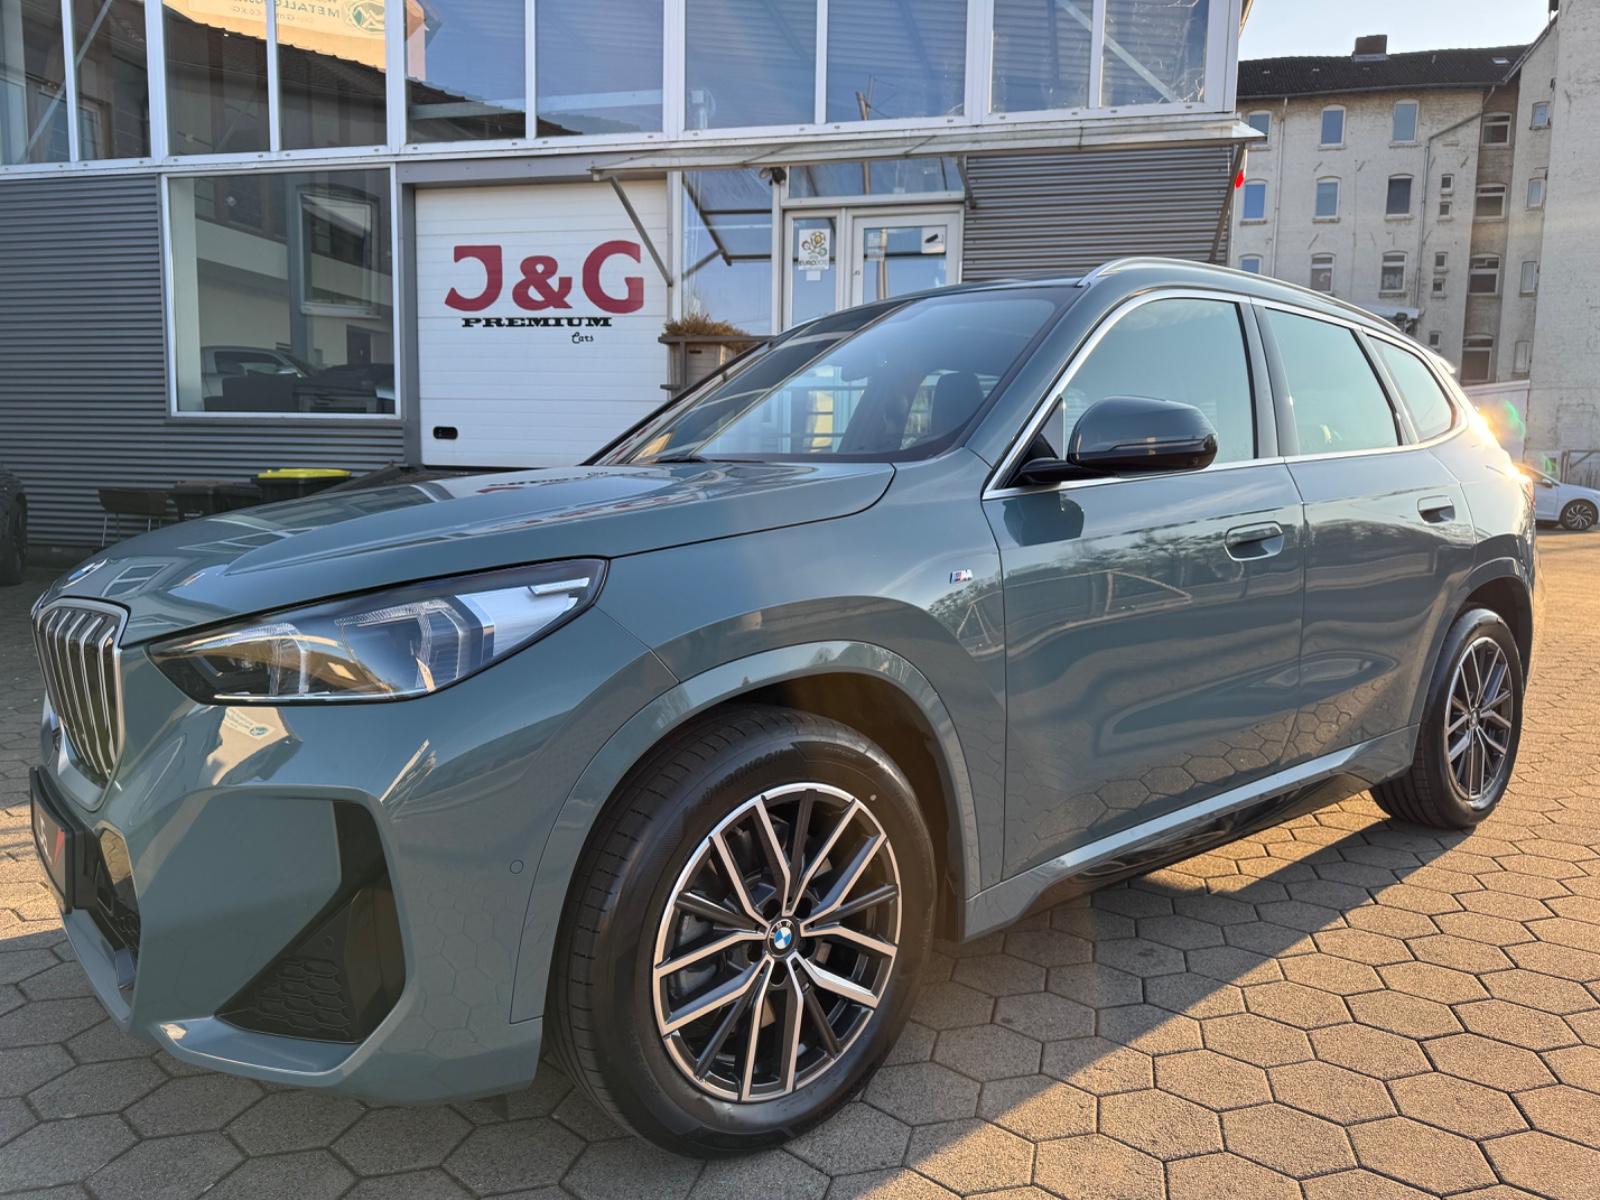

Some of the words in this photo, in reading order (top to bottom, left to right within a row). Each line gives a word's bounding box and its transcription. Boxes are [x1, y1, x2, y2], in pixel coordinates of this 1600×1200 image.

[445, 240, 644, 314] J&G
[462, 317, 613, 327] PREMIUM
[571, 331, 594, 344] Cars
